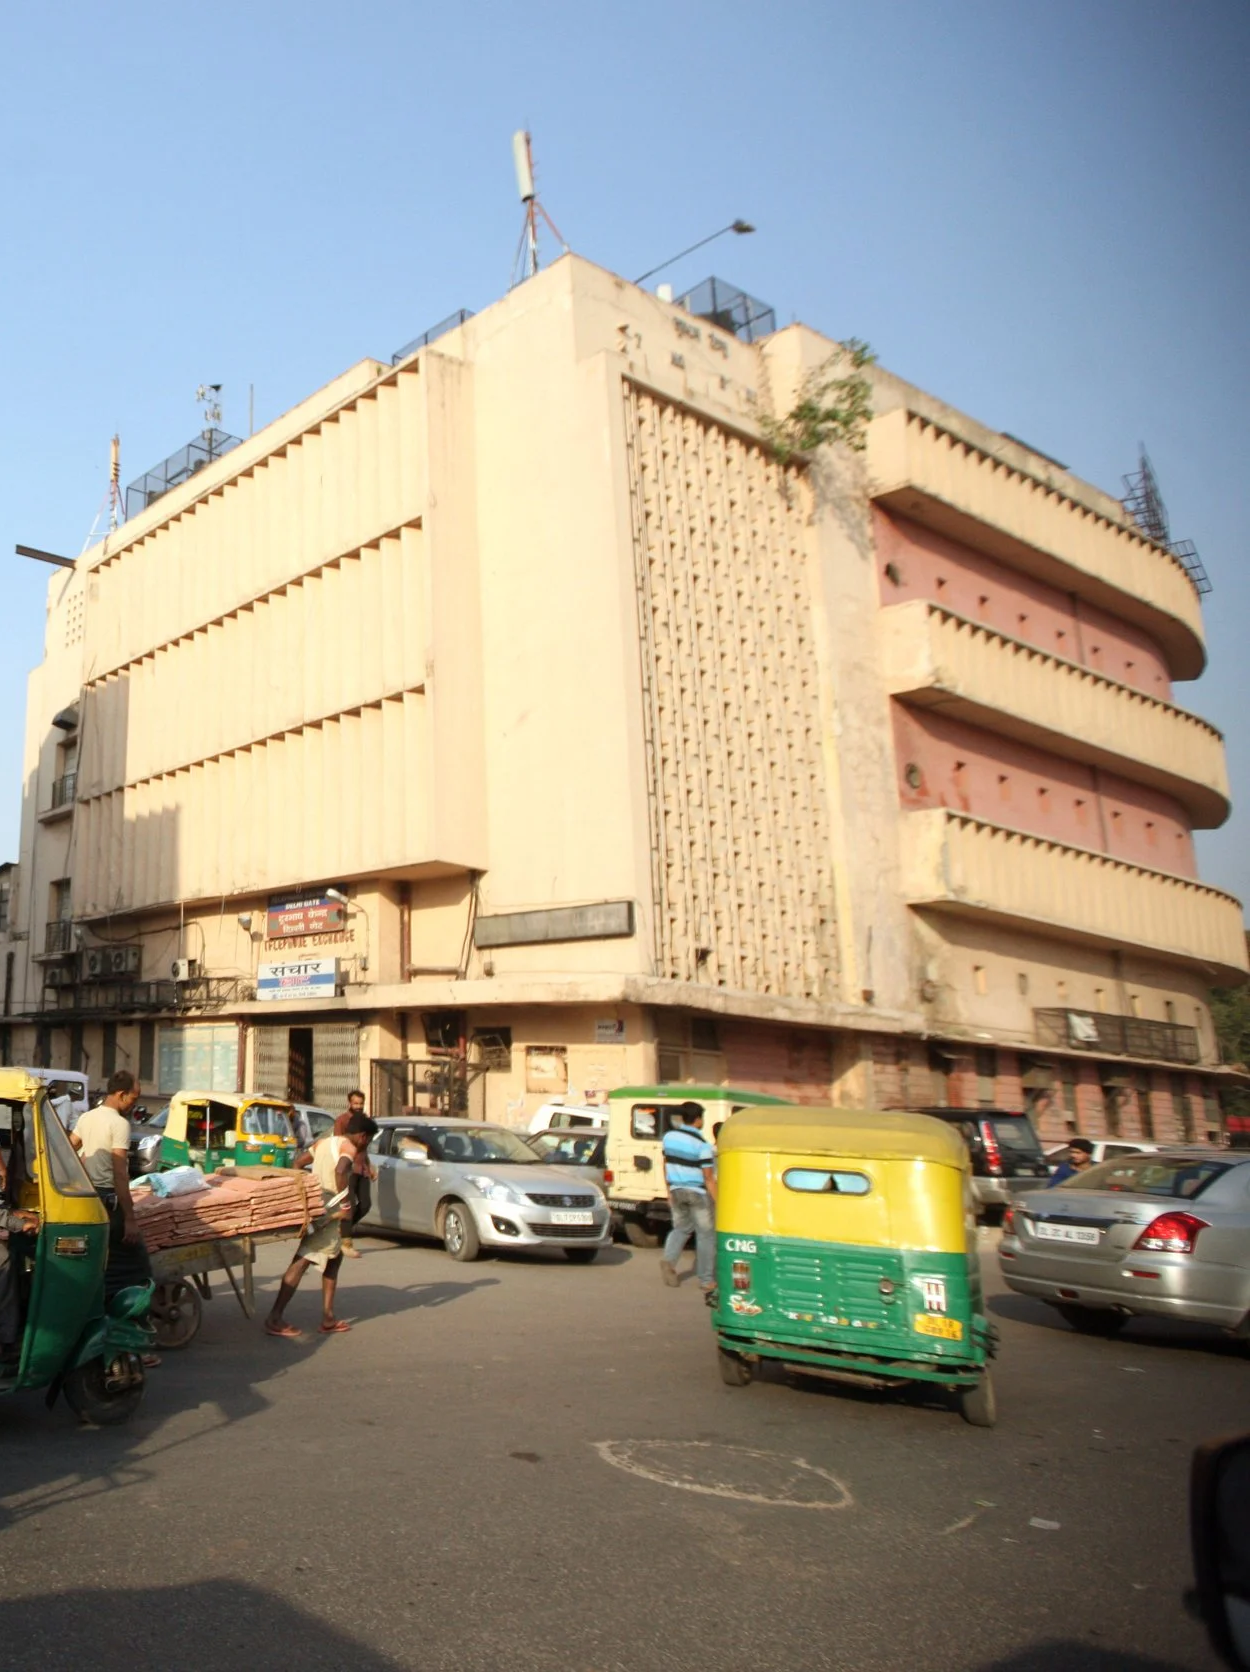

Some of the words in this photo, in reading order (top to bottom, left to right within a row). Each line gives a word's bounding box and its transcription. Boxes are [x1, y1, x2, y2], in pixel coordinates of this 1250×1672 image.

[303, 898, 320, 907] GATE
[312, 929, 356, 947] EXCHANGE
[269, 961, 322, 977] संचार
[725, 1238, 757, 1254] CNG
